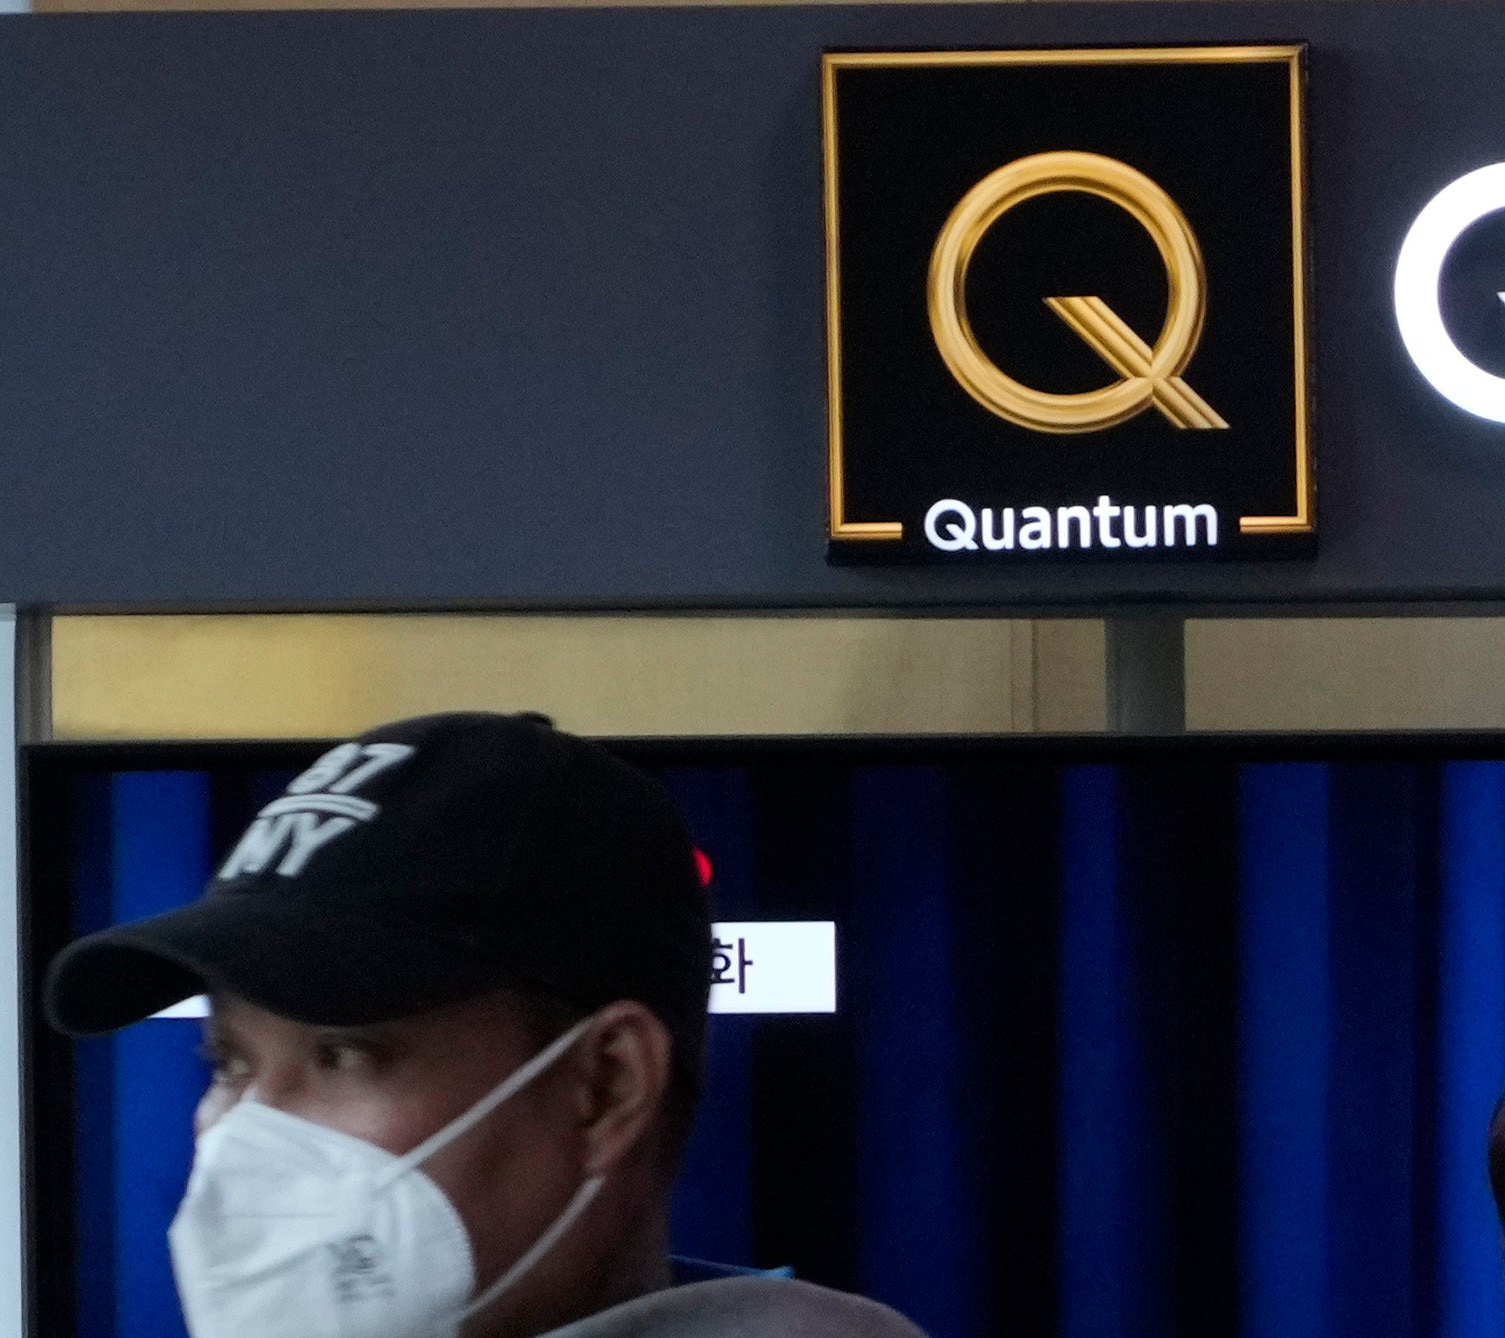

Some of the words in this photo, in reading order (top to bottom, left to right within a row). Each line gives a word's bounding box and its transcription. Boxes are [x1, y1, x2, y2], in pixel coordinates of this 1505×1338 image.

[927, 151, 1231, 434] Q
[924, 494, 1219, 552] Quantum
[218, 811, 356, 879] NY
